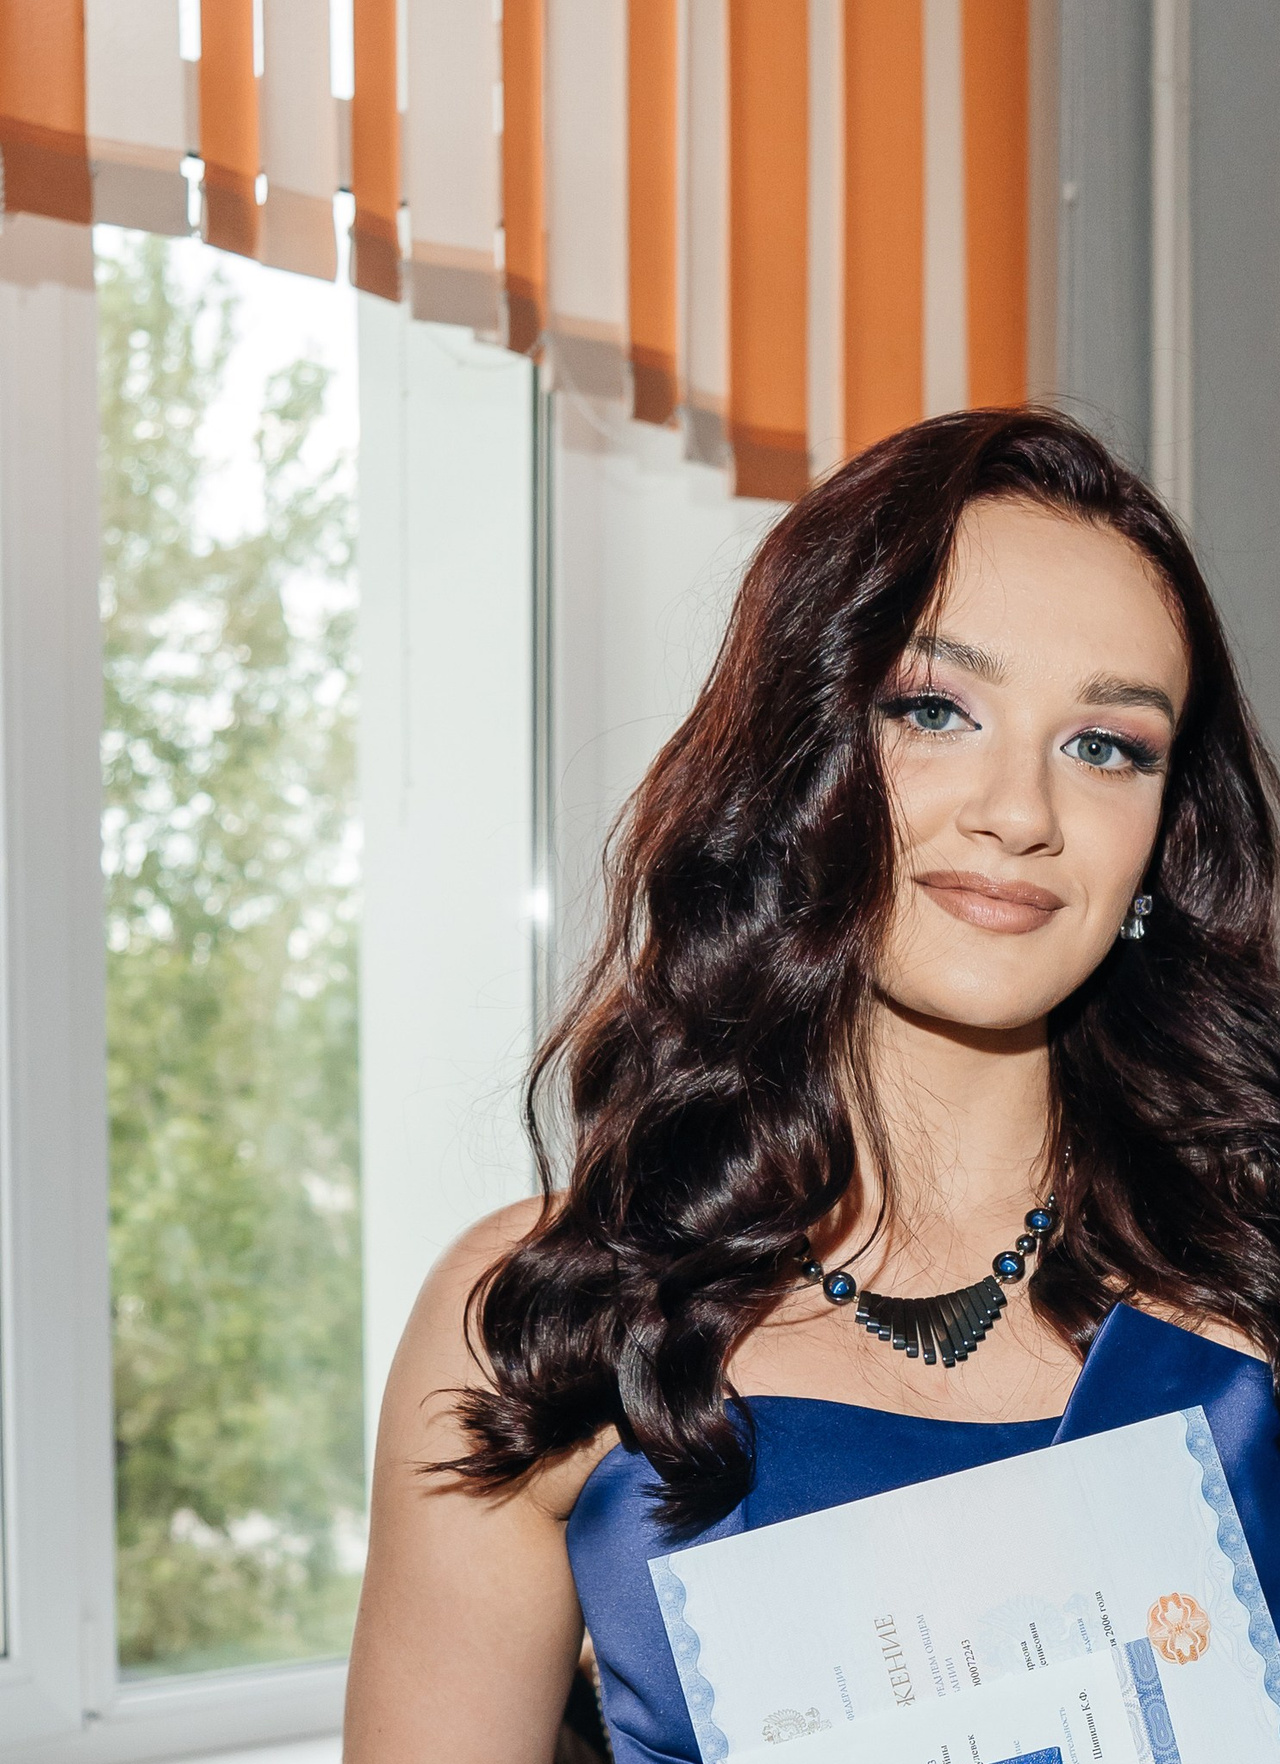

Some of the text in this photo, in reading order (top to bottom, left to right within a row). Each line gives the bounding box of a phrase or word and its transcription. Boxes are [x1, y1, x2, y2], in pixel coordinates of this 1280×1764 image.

[1095, 1590, 1106, 1612] года
[917, 1614, 934, 1654] ОБЩЕМ
[1029, 1622, 1047, 1667] енисовна
[1100, 1614, 1113, 1637] 2006
[834, 1666, 854, 1721] ФЕДЕРАЦИЯ
[1077, 1688, 1102, 1759] Шипилин К.Ф.
